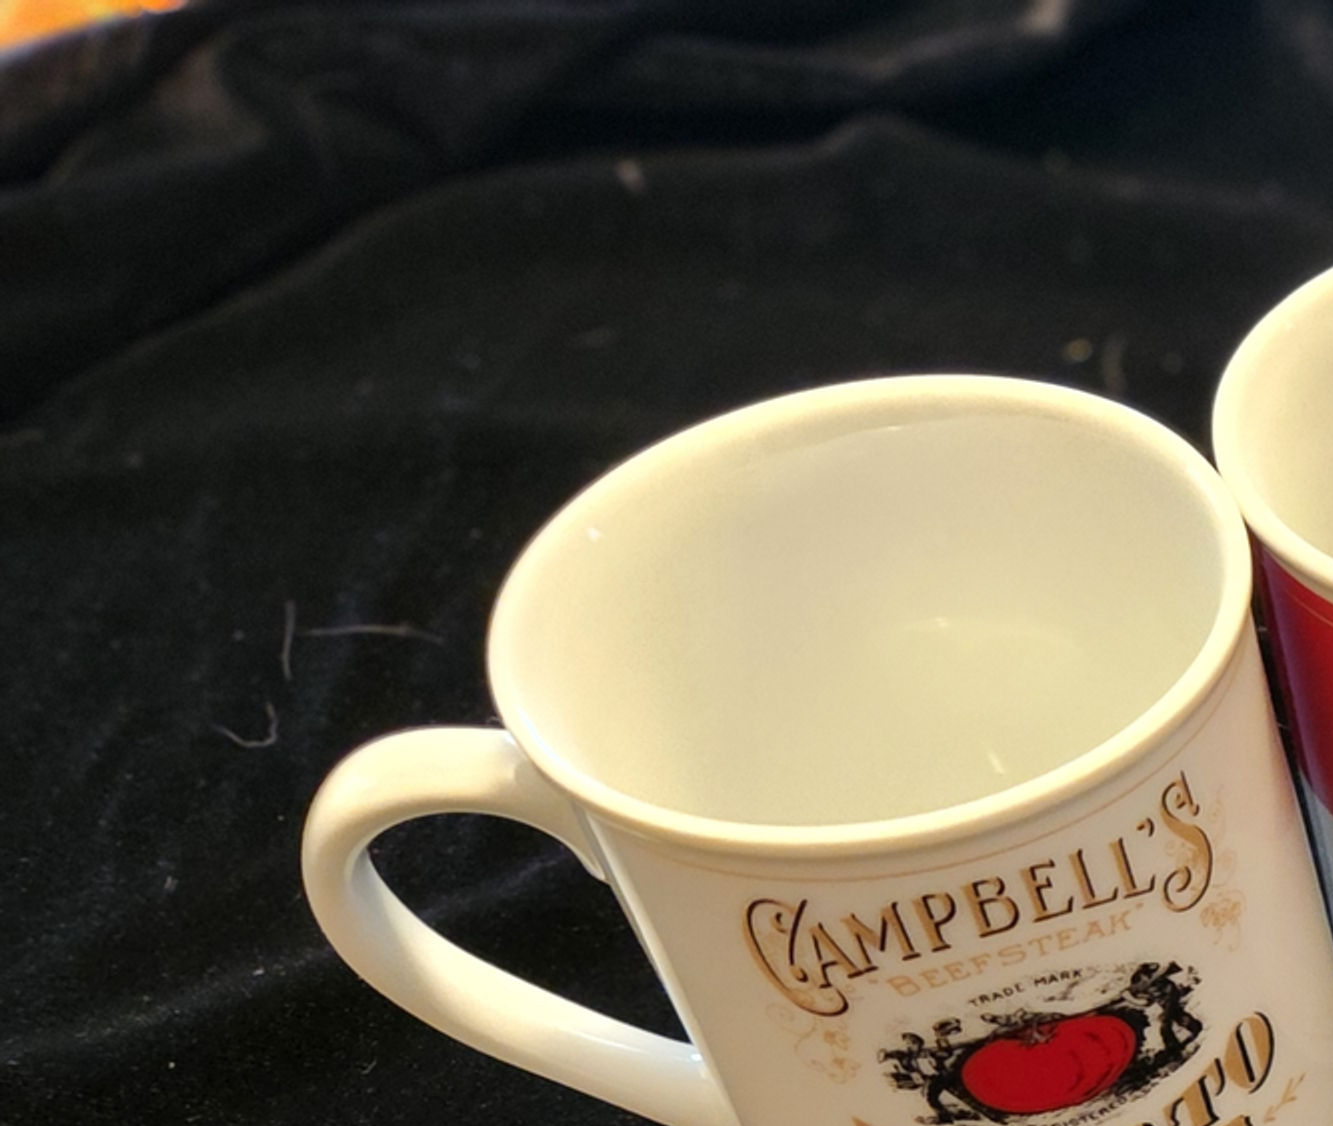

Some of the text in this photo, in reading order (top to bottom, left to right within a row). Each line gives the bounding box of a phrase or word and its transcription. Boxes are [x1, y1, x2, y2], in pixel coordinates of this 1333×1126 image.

[741, 770, 1213, 1017] CAMPBELL'S
[968, 969, 1083, 1007] TRADE MARK
